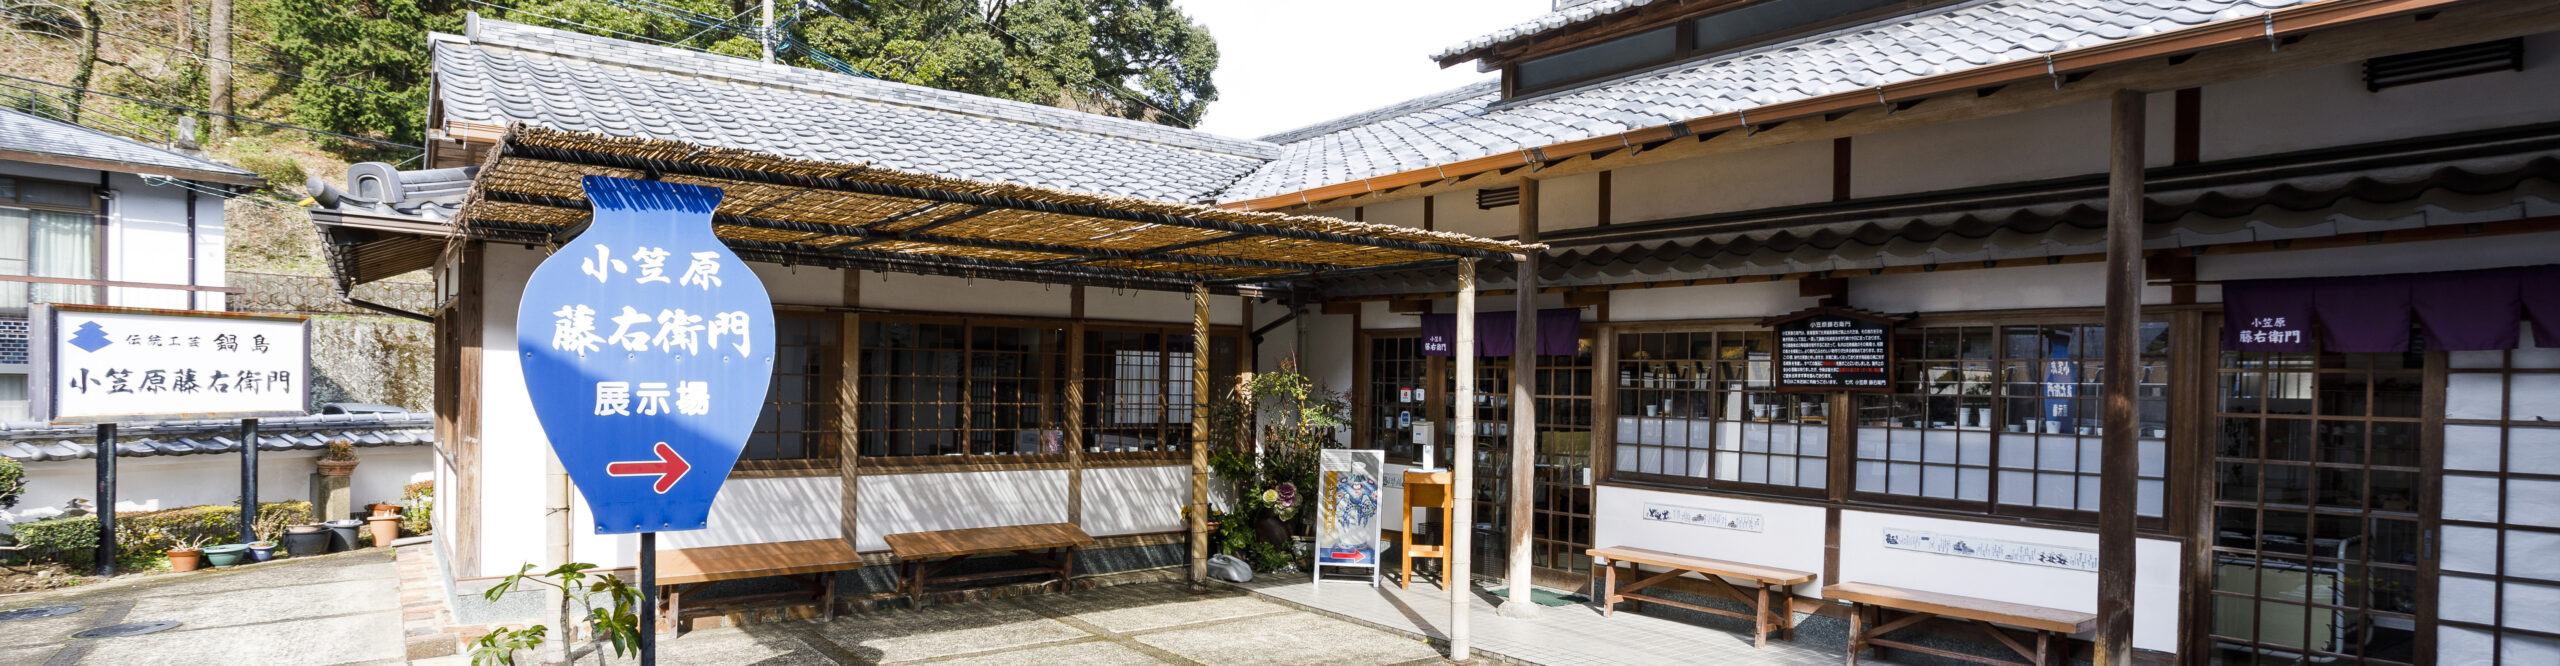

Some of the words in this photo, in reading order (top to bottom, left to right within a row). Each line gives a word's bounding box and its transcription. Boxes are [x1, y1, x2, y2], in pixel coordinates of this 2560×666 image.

[581, 244, 722, 291] 小笠原
[552, 304, 751, 358] 藤右衛門
[2251, 317, 2286, 328] 小笠原
[126, 334, 201, 347] 伝統工芸
[213, 333, 271, 354] 鍋島
[2239, 330, 2301, 343] 藤右衛門
[70, 367, 291, 394] 小笠原藤右衛門
[594, 380, 710, 416] 展示場
